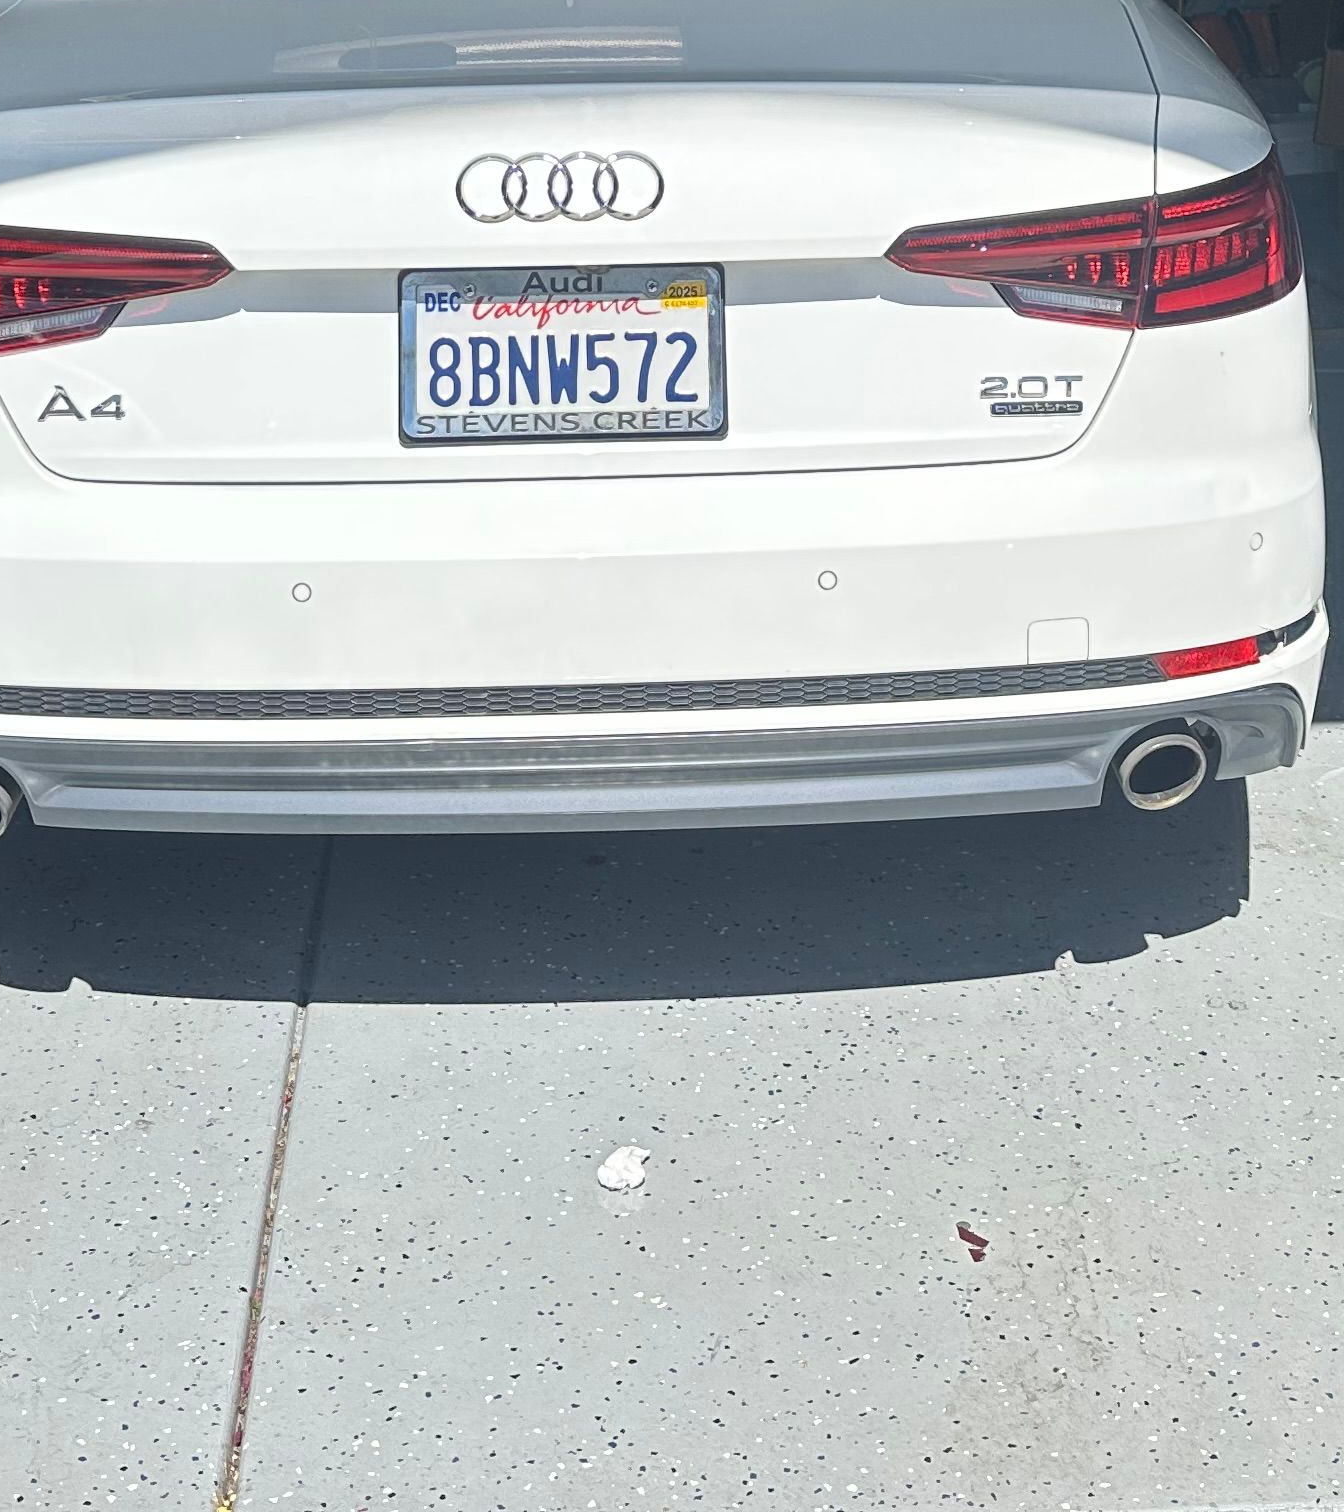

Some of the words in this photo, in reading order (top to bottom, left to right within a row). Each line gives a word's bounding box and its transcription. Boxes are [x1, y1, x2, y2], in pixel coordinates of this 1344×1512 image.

[522, 271, 603, 294] Audi
[668, 285, 698, 298] 2025
[424, 292, 461, 313] DEC
[472, 294, 661, 329] California
[429, 332, 698, 406] 8BNW572
[980, 375, 1083, 400] 2.0T
[37, 385, 126, 422] A4
[994, 402, 1080, 415] quattro
[416, 412, 582, 435] STEVENS
[594, 409, 710, 431] CREEK
